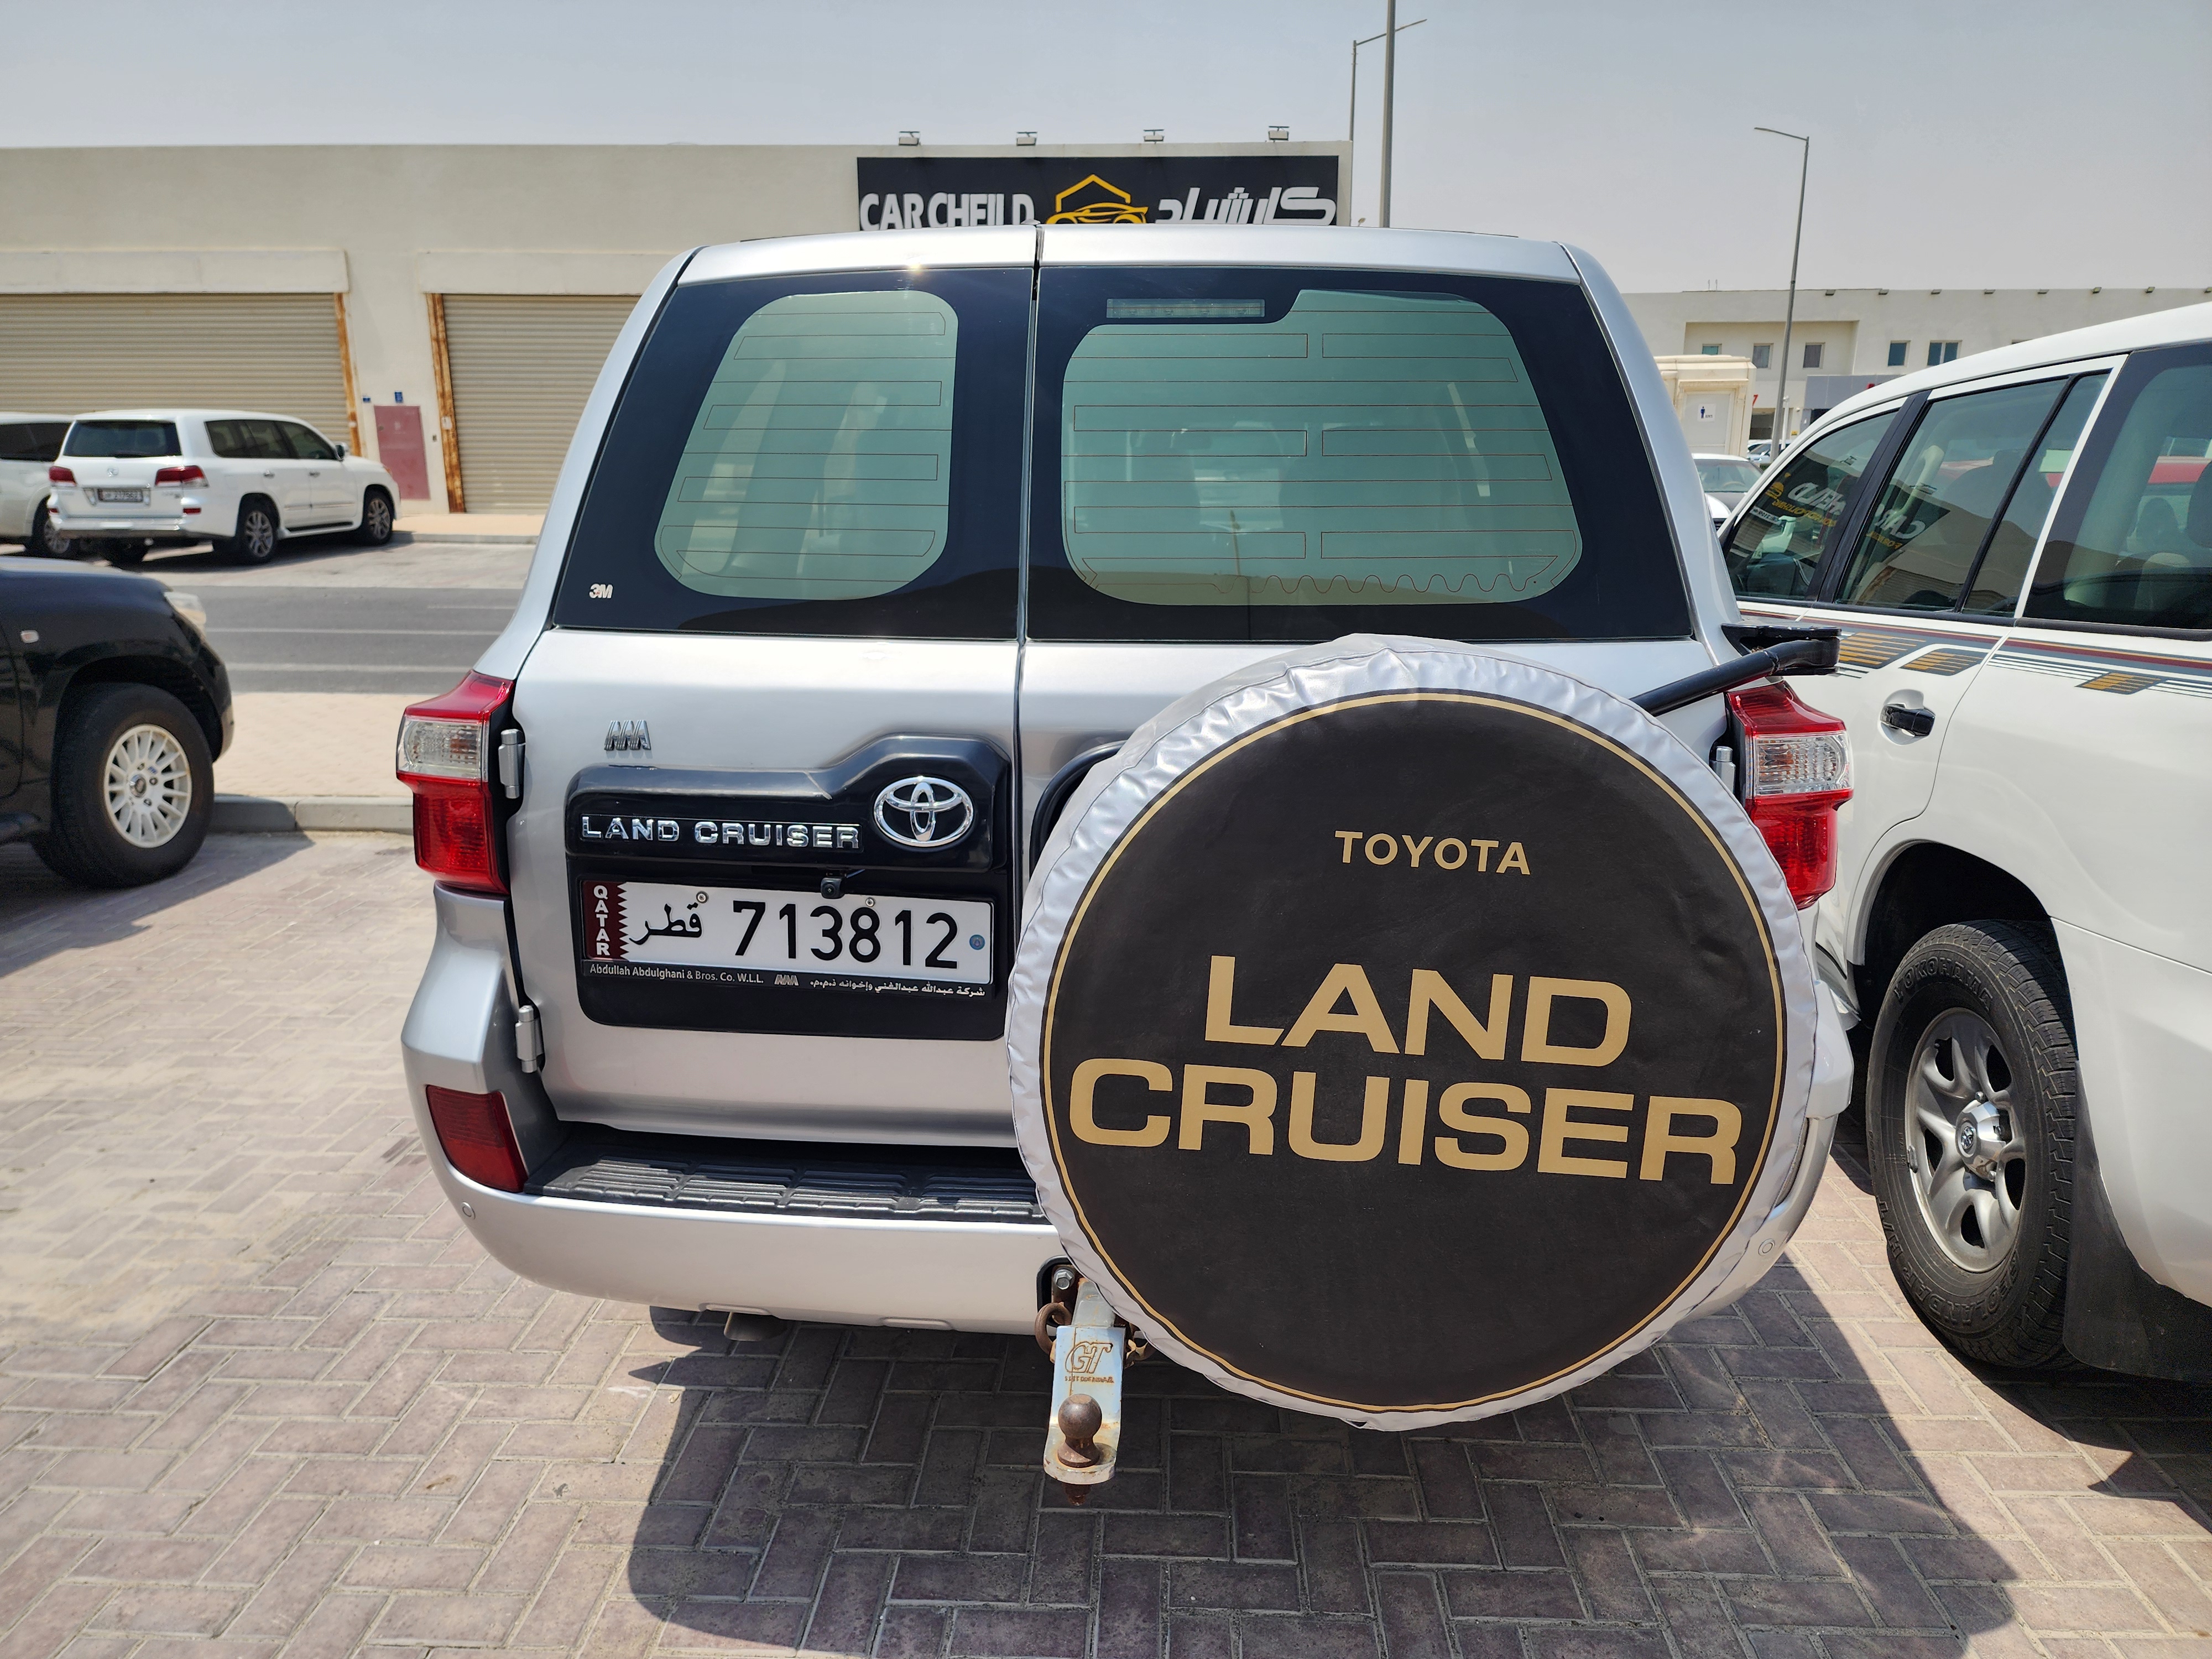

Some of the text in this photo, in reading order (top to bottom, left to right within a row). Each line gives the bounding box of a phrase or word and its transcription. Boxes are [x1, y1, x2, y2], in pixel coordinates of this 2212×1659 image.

[860, 193, 924, 231] CAR
[589, 583, 613, 599] 3M
[582, 816, 859, 849] LAND CRUISER
[1335, 831, 1531, 875] TOYOTA
[594, 885, 611, 956] QATAR
[628, 901, 702, 946] قطر
[732, 900, 958, 969] 713812
[589, 963, 764, 984] Abdullah Abdulghani & Bros. Co. W.L.L.
[874, 982, 919, 994] عبدالغني
[921, 982, 954, 995] عبدالله
[956, 986, 985, 997] شركة
[1205, 955, 1632, 1067] LAND
[1070, 1058, 1742, 1184] CRUISER
[1065, 1340, 1114, 1374] GT
